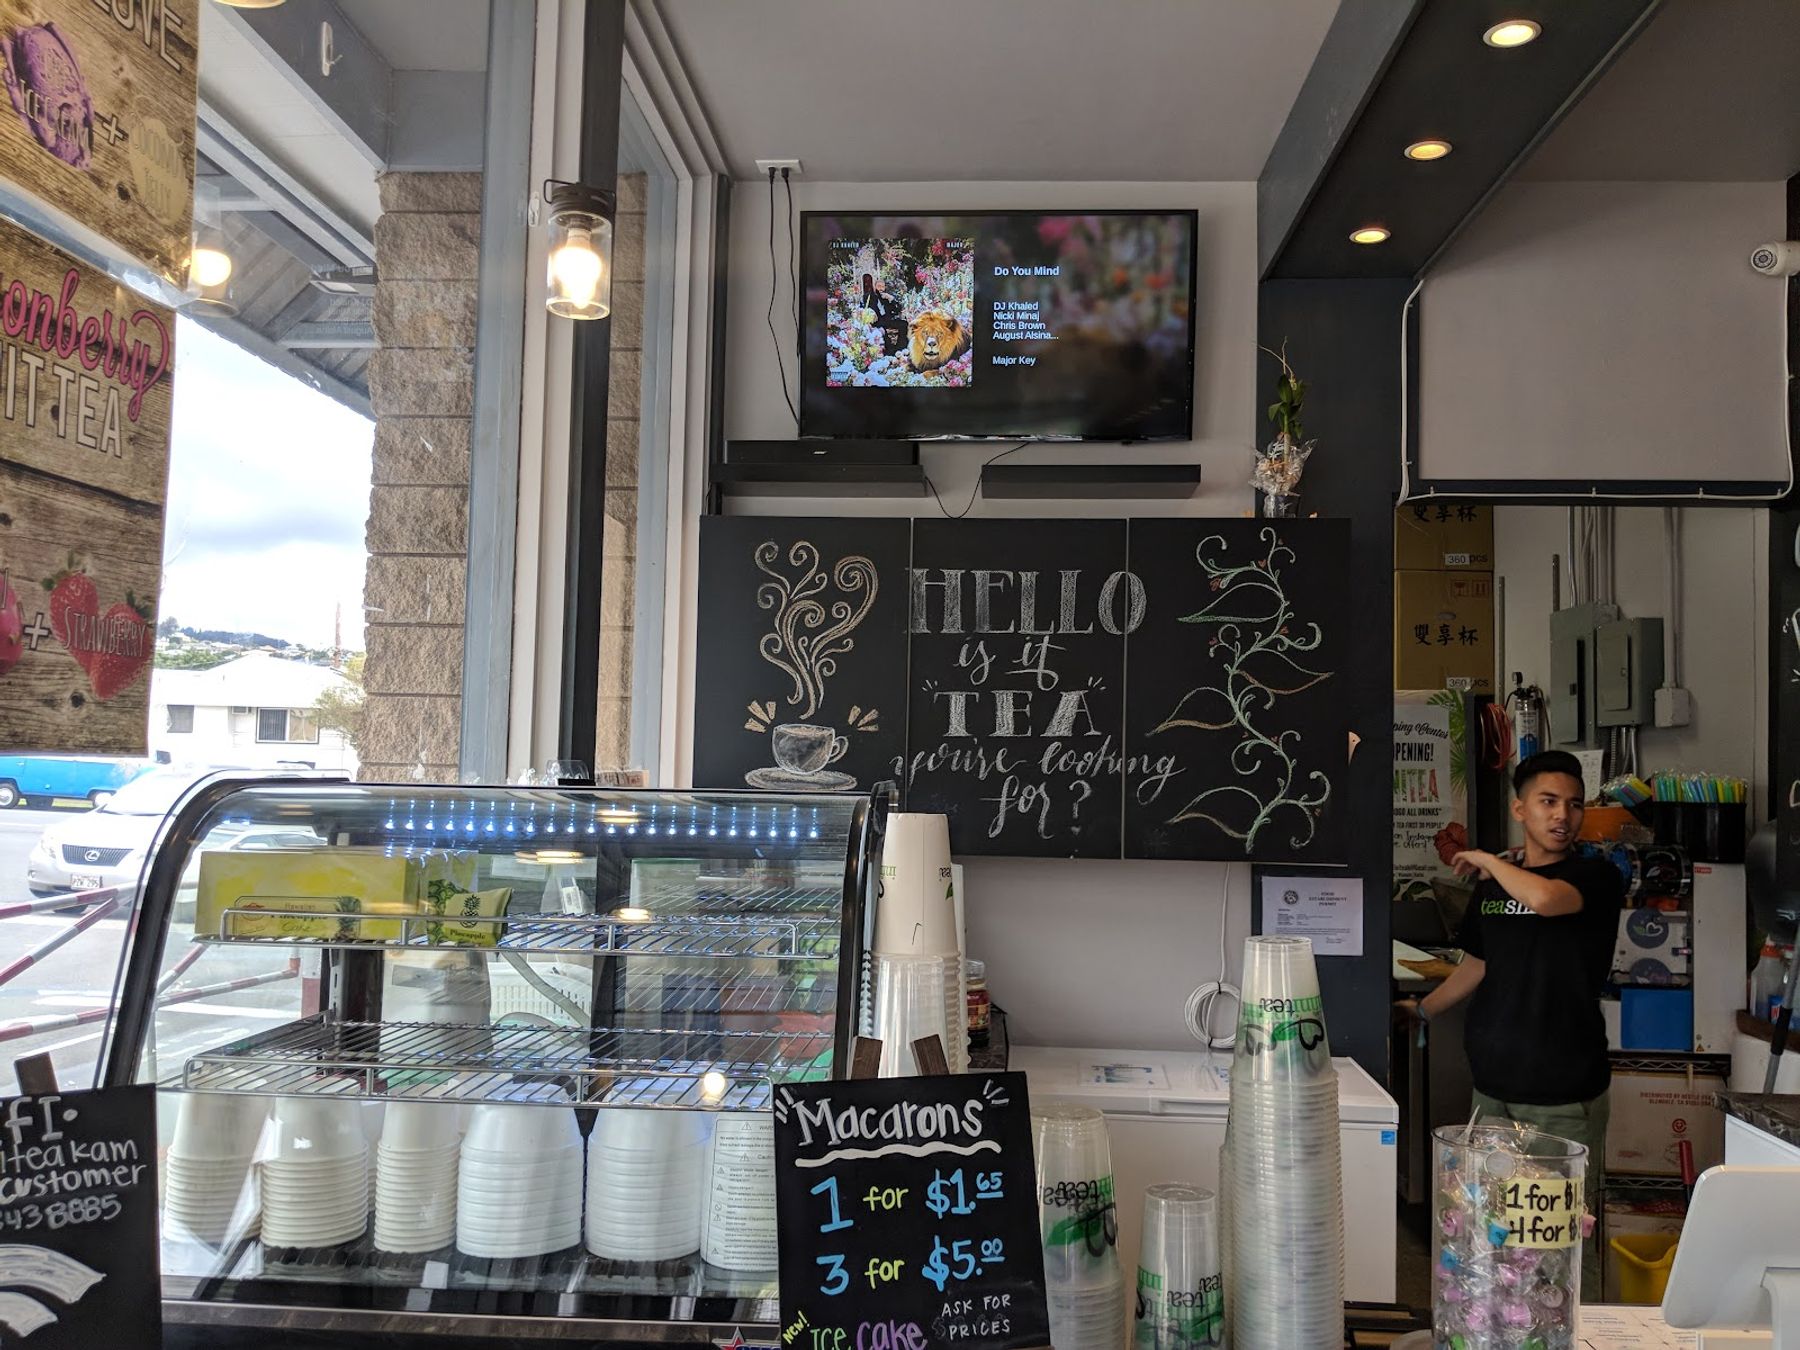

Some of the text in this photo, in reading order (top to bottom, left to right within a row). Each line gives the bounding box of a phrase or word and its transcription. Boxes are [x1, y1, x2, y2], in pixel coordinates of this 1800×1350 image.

[994, 266, 1060, 276] Do You Mind
[993, 302, 1039, 311] DJ Khaled
[993, 312, 1040, 322] Nicki Minaj
[992, 331, 1023, 342] August
[993, 321, 1046, 330] Chris Brown
[0, 268, 169, 422] onberry
[992, 356, 1036, 367] Major Key
[0, 342, 122, 459] IT TEA
[1448, 554, 1467, 565] 360
[904, 567, 1148, 636] HELLO
[1413, 623, 1479, 647] 雙享杯
[953, 634, 1067, 691] is it
[933, 689, 1102, 738] TEA
[1414, 722, 1449, 740] Center
[1392, 742, 1435, 762] PENING!
[1038, 734, 1187, 806] looking
[792, 1096, 984, 1147] Macarons
[0, 1164, 148, 1205] customer
[1506, 1183, 1525, 1209] 1
[1524, 1184, 1562, 1212] for
[810, 1175, 854, 1233] 1
[862, 1186, 910, 1211] for
[1527, 1216, 1566, 1243] for
[815, 1253, 850, 1296] 3
[864, 1257, 906, 1290] for
[921, 1235, 1006, 1292] $5.00
[941, 1293, 1012, 1318] ASK FOR
[948, 1318, 1011, 1341] PRICES
